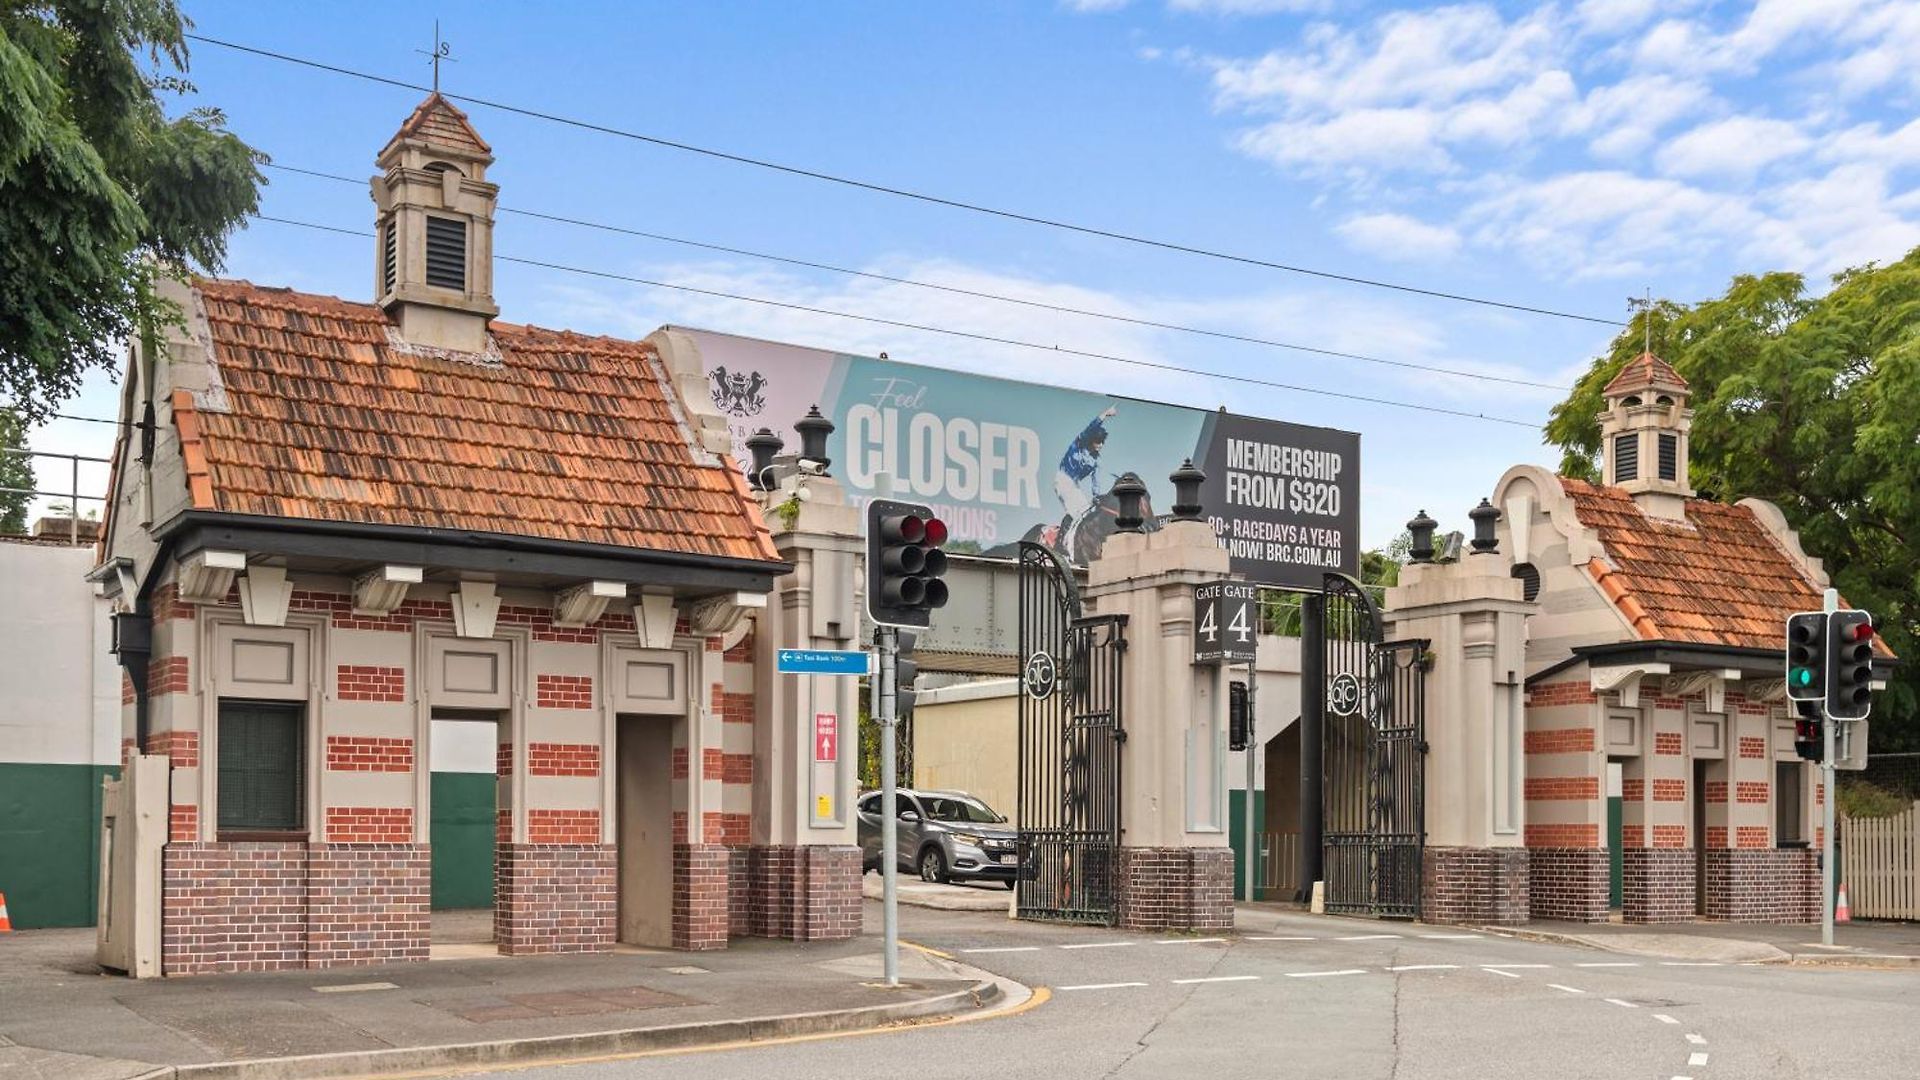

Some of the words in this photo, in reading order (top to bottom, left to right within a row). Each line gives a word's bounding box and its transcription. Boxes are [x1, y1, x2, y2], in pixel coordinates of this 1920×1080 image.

[870, 377, 928, 411] Feel
[846, 403, 1041, 509] CLOSER
[1226, 438, 1342, 482] MEMBERSHIP
[1226, 471, 1286, 511] FROM
[1289, 477, 1341, 517] $320
[1233, 519, 1297, 544] RACEDAYS
[1299, 526, 1308, 545] A
[1309, 527, 1341, 549] YEAR
[1229, 540, 1264, 560] NOW!
[1266, 546, 1341, 568] BRC.COM.AU
[1196, 585, 1221, 600] GATE
[1224, 585, 1254, 600] GATE
[1199, 601, 1218, 642] 4
[1228, 601, 1252, 642] 4
